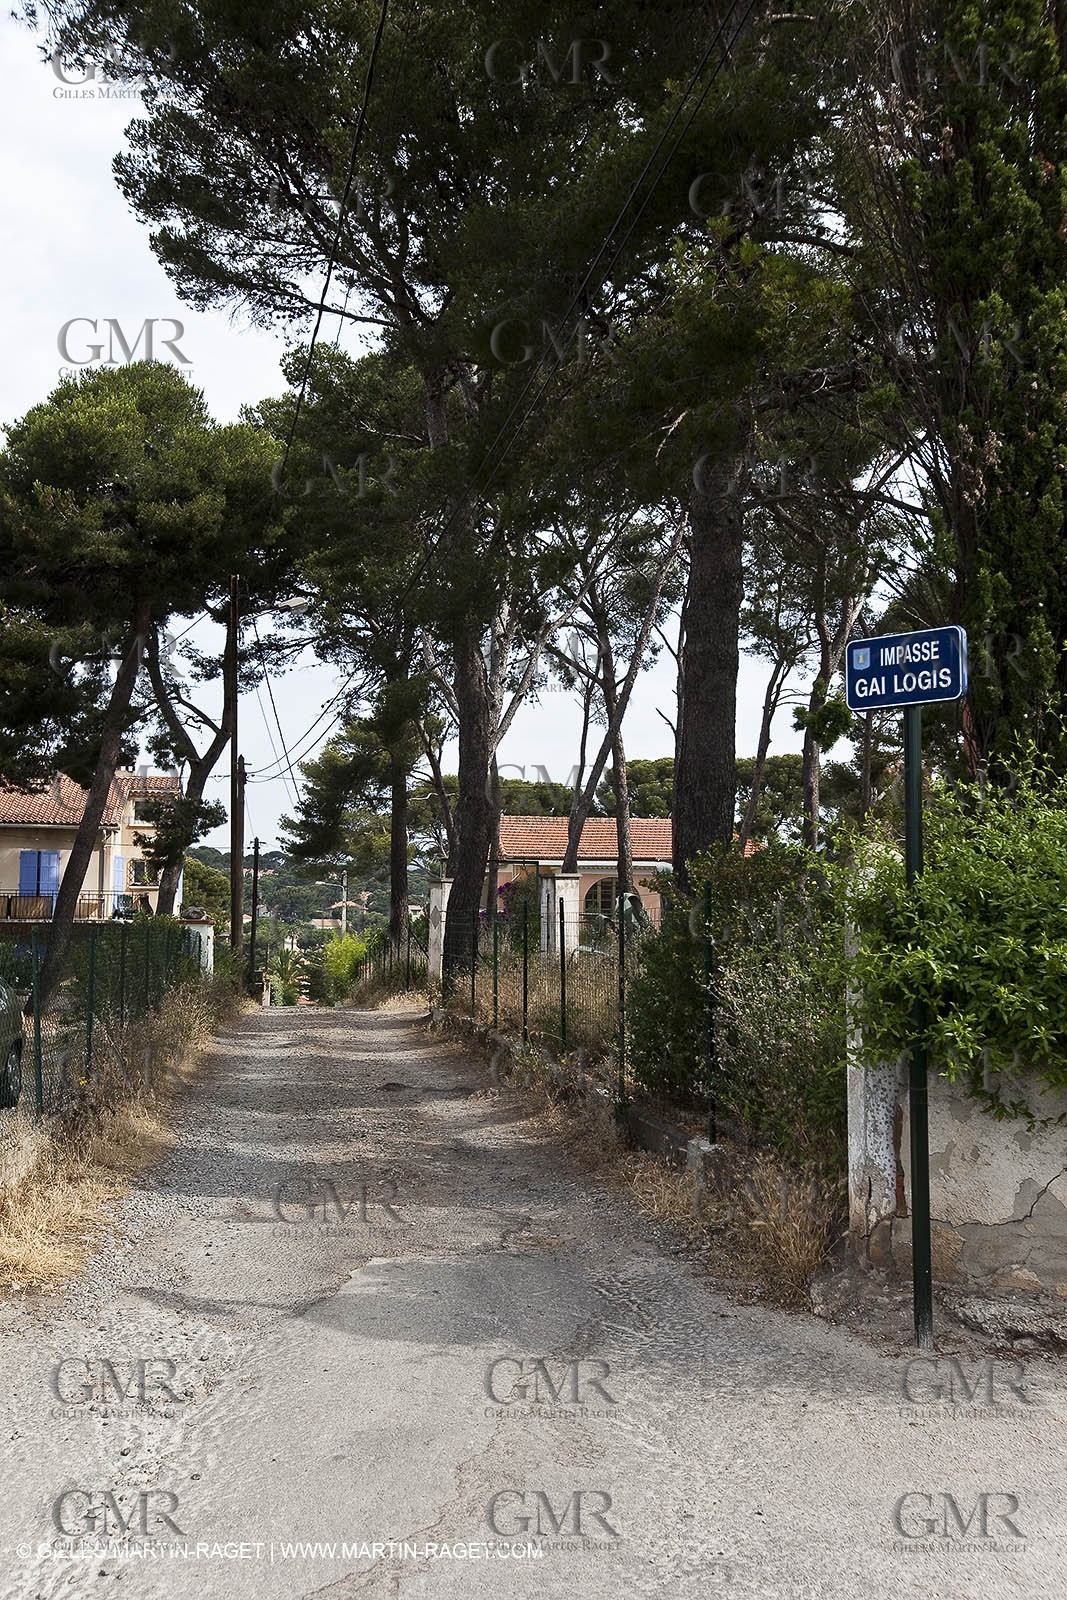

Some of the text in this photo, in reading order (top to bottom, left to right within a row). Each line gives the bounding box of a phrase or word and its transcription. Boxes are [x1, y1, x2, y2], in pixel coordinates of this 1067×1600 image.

[880, 641, 940, 666] IMPASSE
[855, 667, 952, 697] GAI LOGIS
